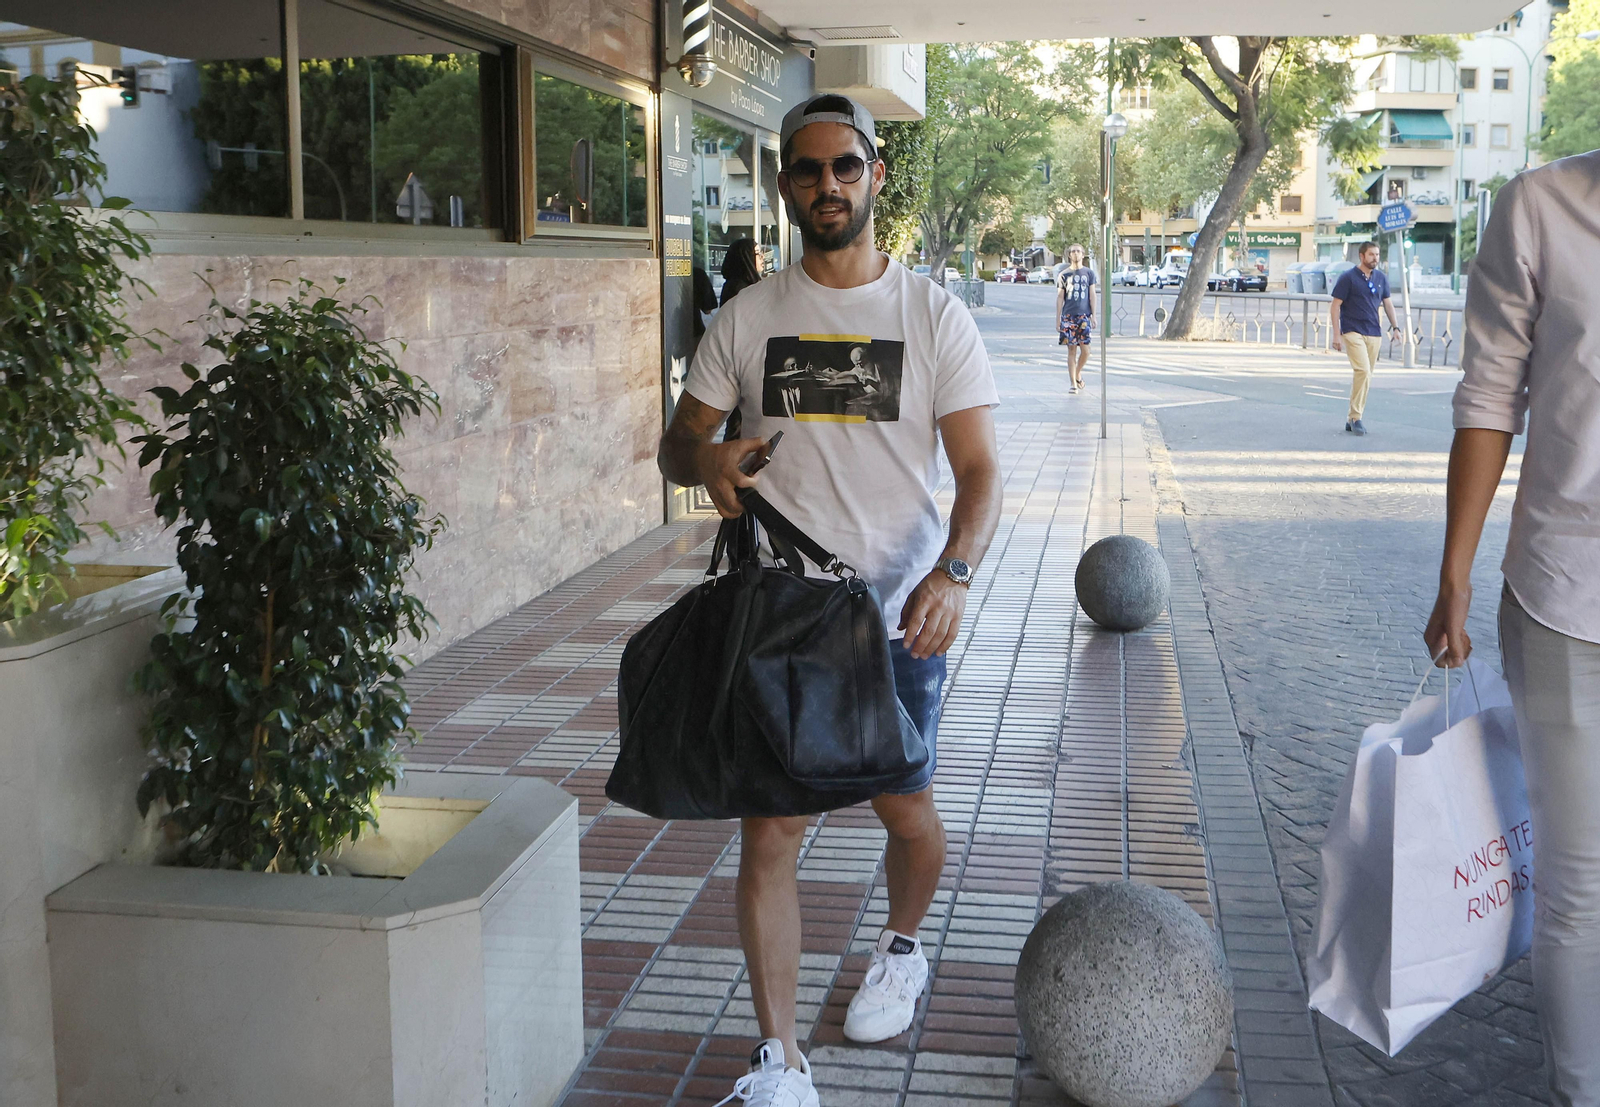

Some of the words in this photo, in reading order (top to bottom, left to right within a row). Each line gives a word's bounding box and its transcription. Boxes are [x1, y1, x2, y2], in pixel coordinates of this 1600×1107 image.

[728, 29, 759, 78] BARBER
[760, 50, 781, 88] SHOP
[730, 85, 738, 108] by
[739, 88, 751, 111] Paco
[1385, 214, 1397, 222] LUIS
[1385, 218, 1407, 228] MORALES
[1386, 206, 1402, 215] CALLE
[1454, 835, 1512, 889] NUNCA
[1509, 820, 1533, 852] TE
[1467, 864, 1530, 923] RINDAS
